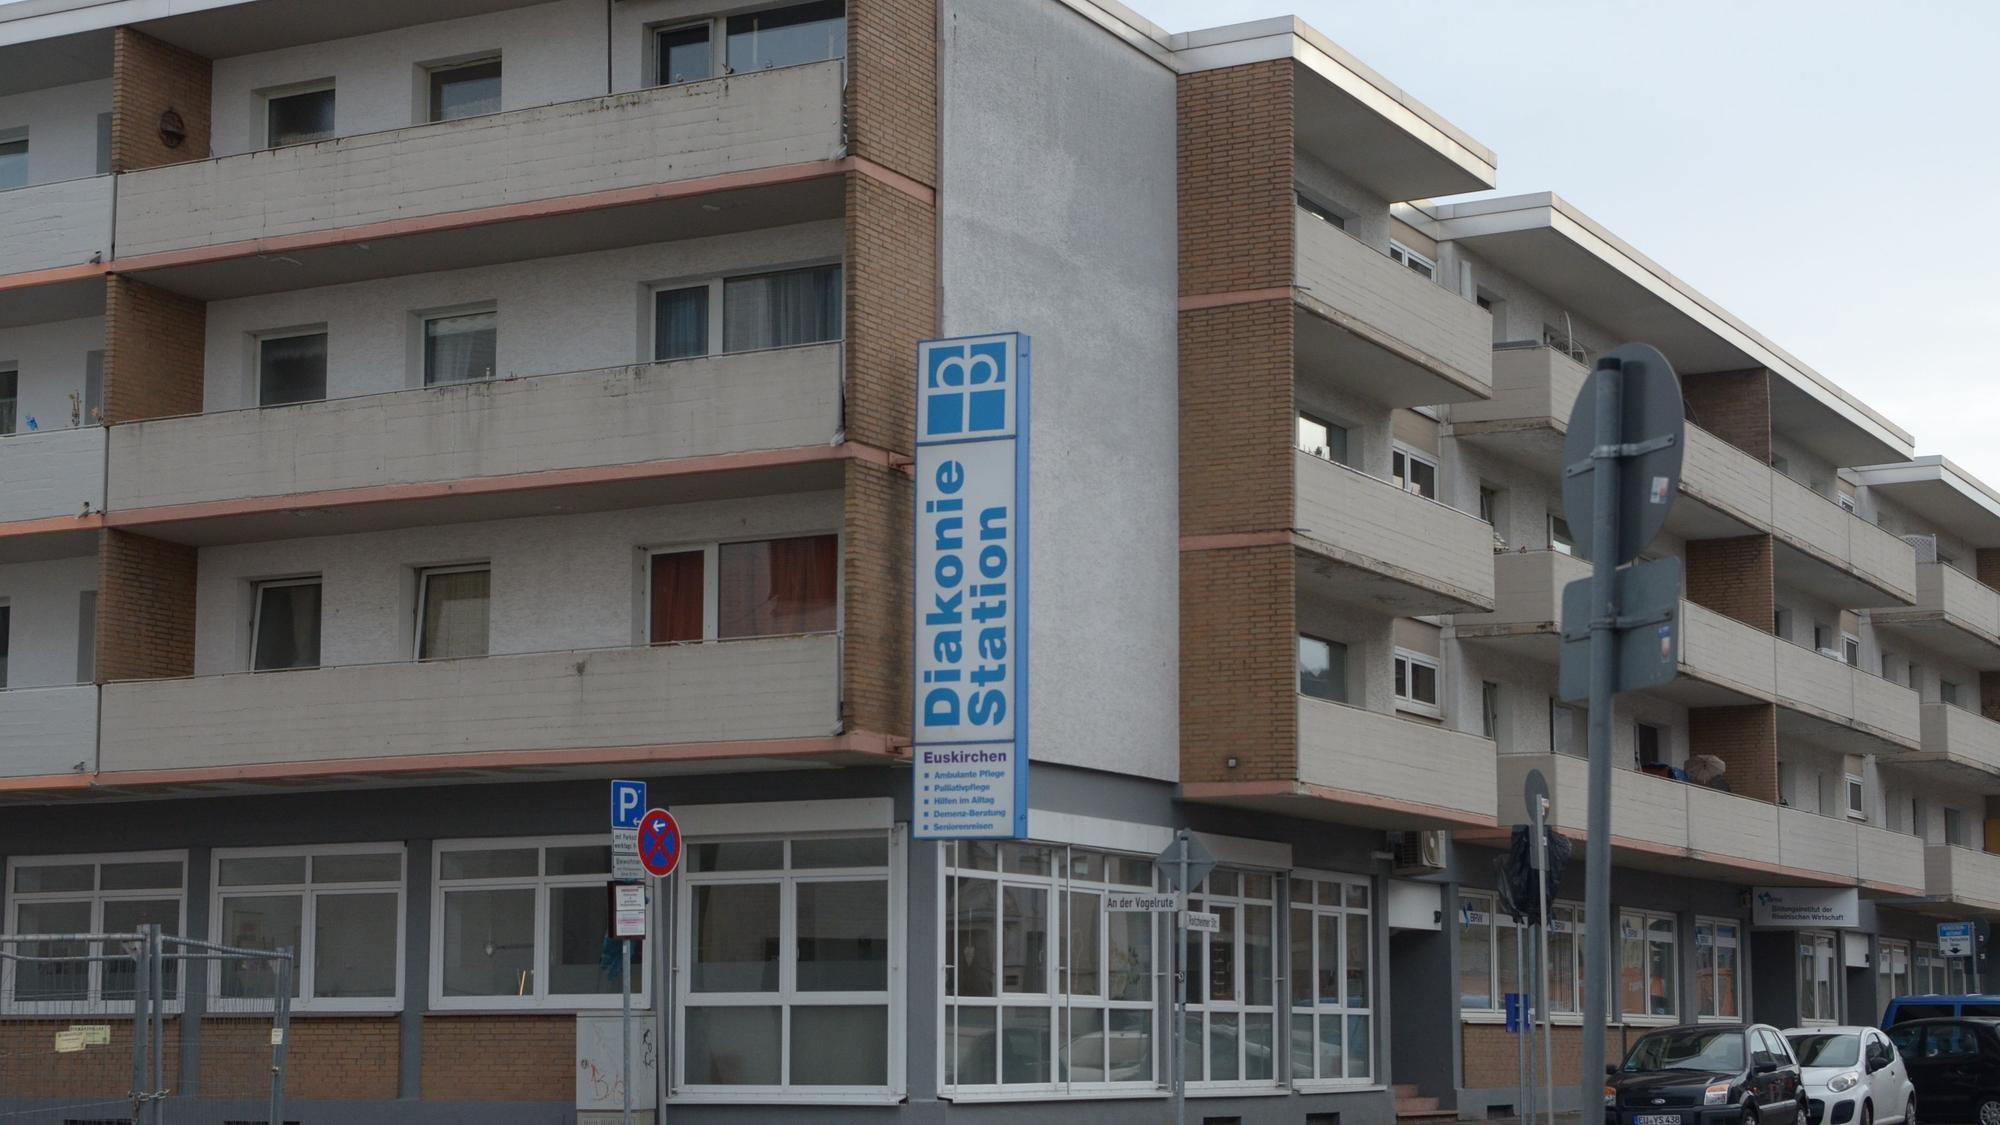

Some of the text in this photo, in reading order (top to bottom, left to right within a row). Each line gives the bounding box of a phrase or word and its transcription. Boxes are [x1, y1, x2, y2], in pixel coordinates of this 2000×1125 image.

[923, 459, 965, 727] Diakonie
[967, 506, 1008, 727] Station
[923, 750, 1007, 764] Euskirchen
[934, 769, 1005, 779] Ambulante Pflege
[934, 783, 990, 792] Palliativpflege
[620, 787, 638, 822] P
[934, 796, 995, 805] Hilfen im Alltag
[933, 809, 1006, 818] Demenz-Beratung
[933, 823, 994, 831] Seniorenreisen
[1107, 898, 1174, 910] An der Vogelrute
